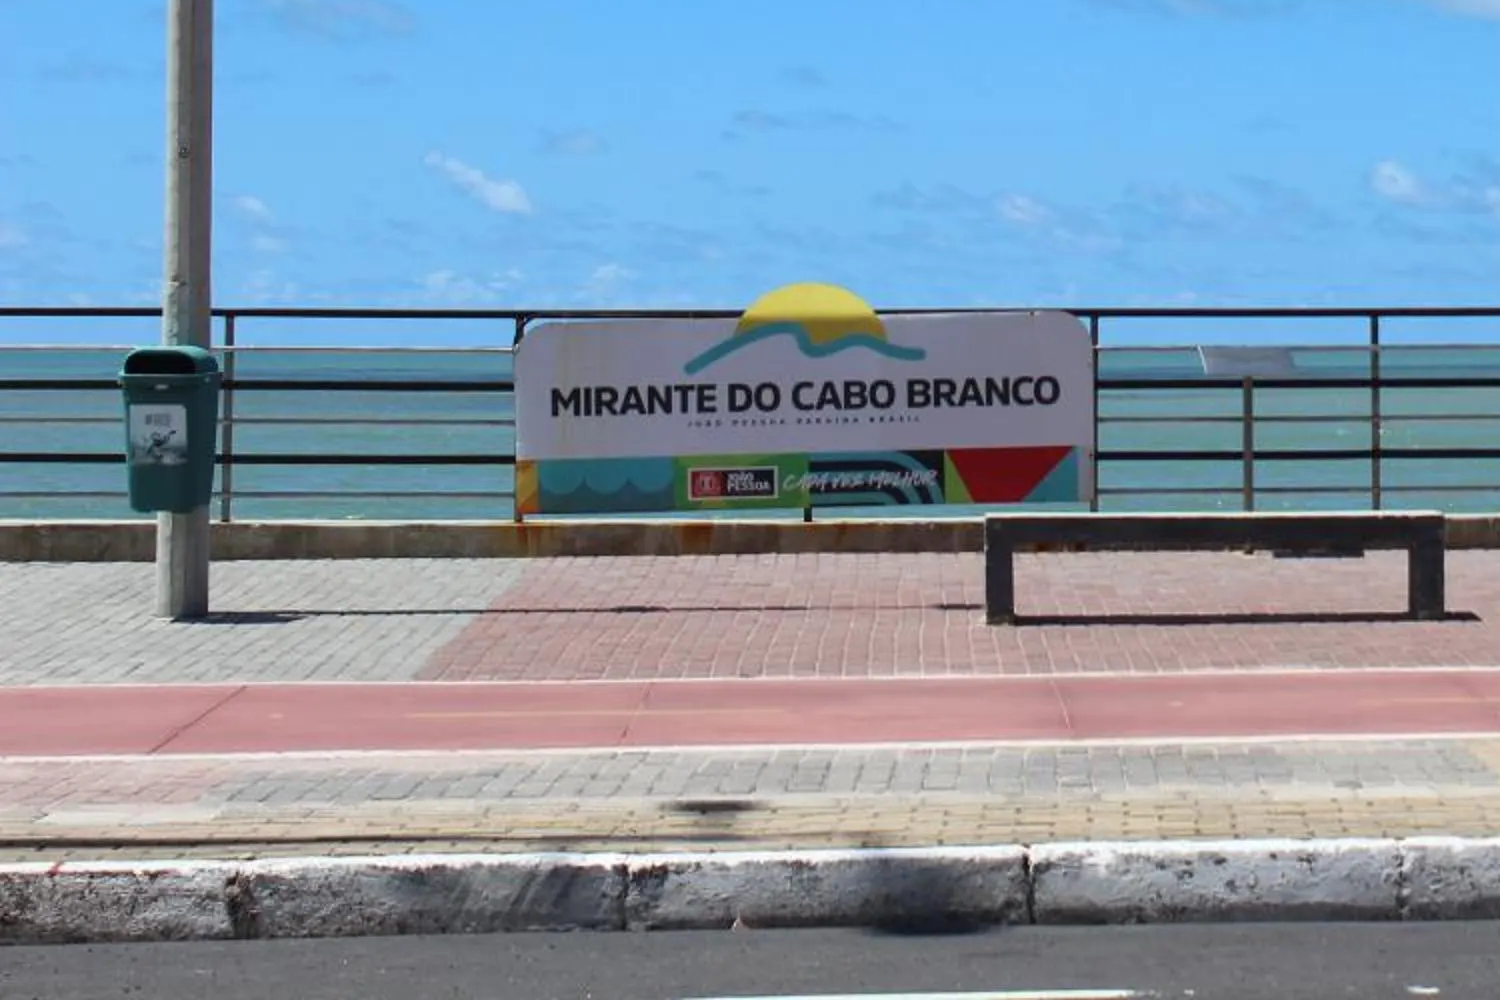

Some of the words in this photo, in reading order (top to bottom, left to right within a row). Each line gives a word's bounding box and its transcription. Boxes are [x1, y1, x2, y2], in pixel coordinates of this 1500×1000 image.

[551, 384, 717, 417] MIRANTE
[728, 382, 781, 413] DO
[791, 379, 896, 411] CABO
[906, 376, 1060, 409] BRANCO
